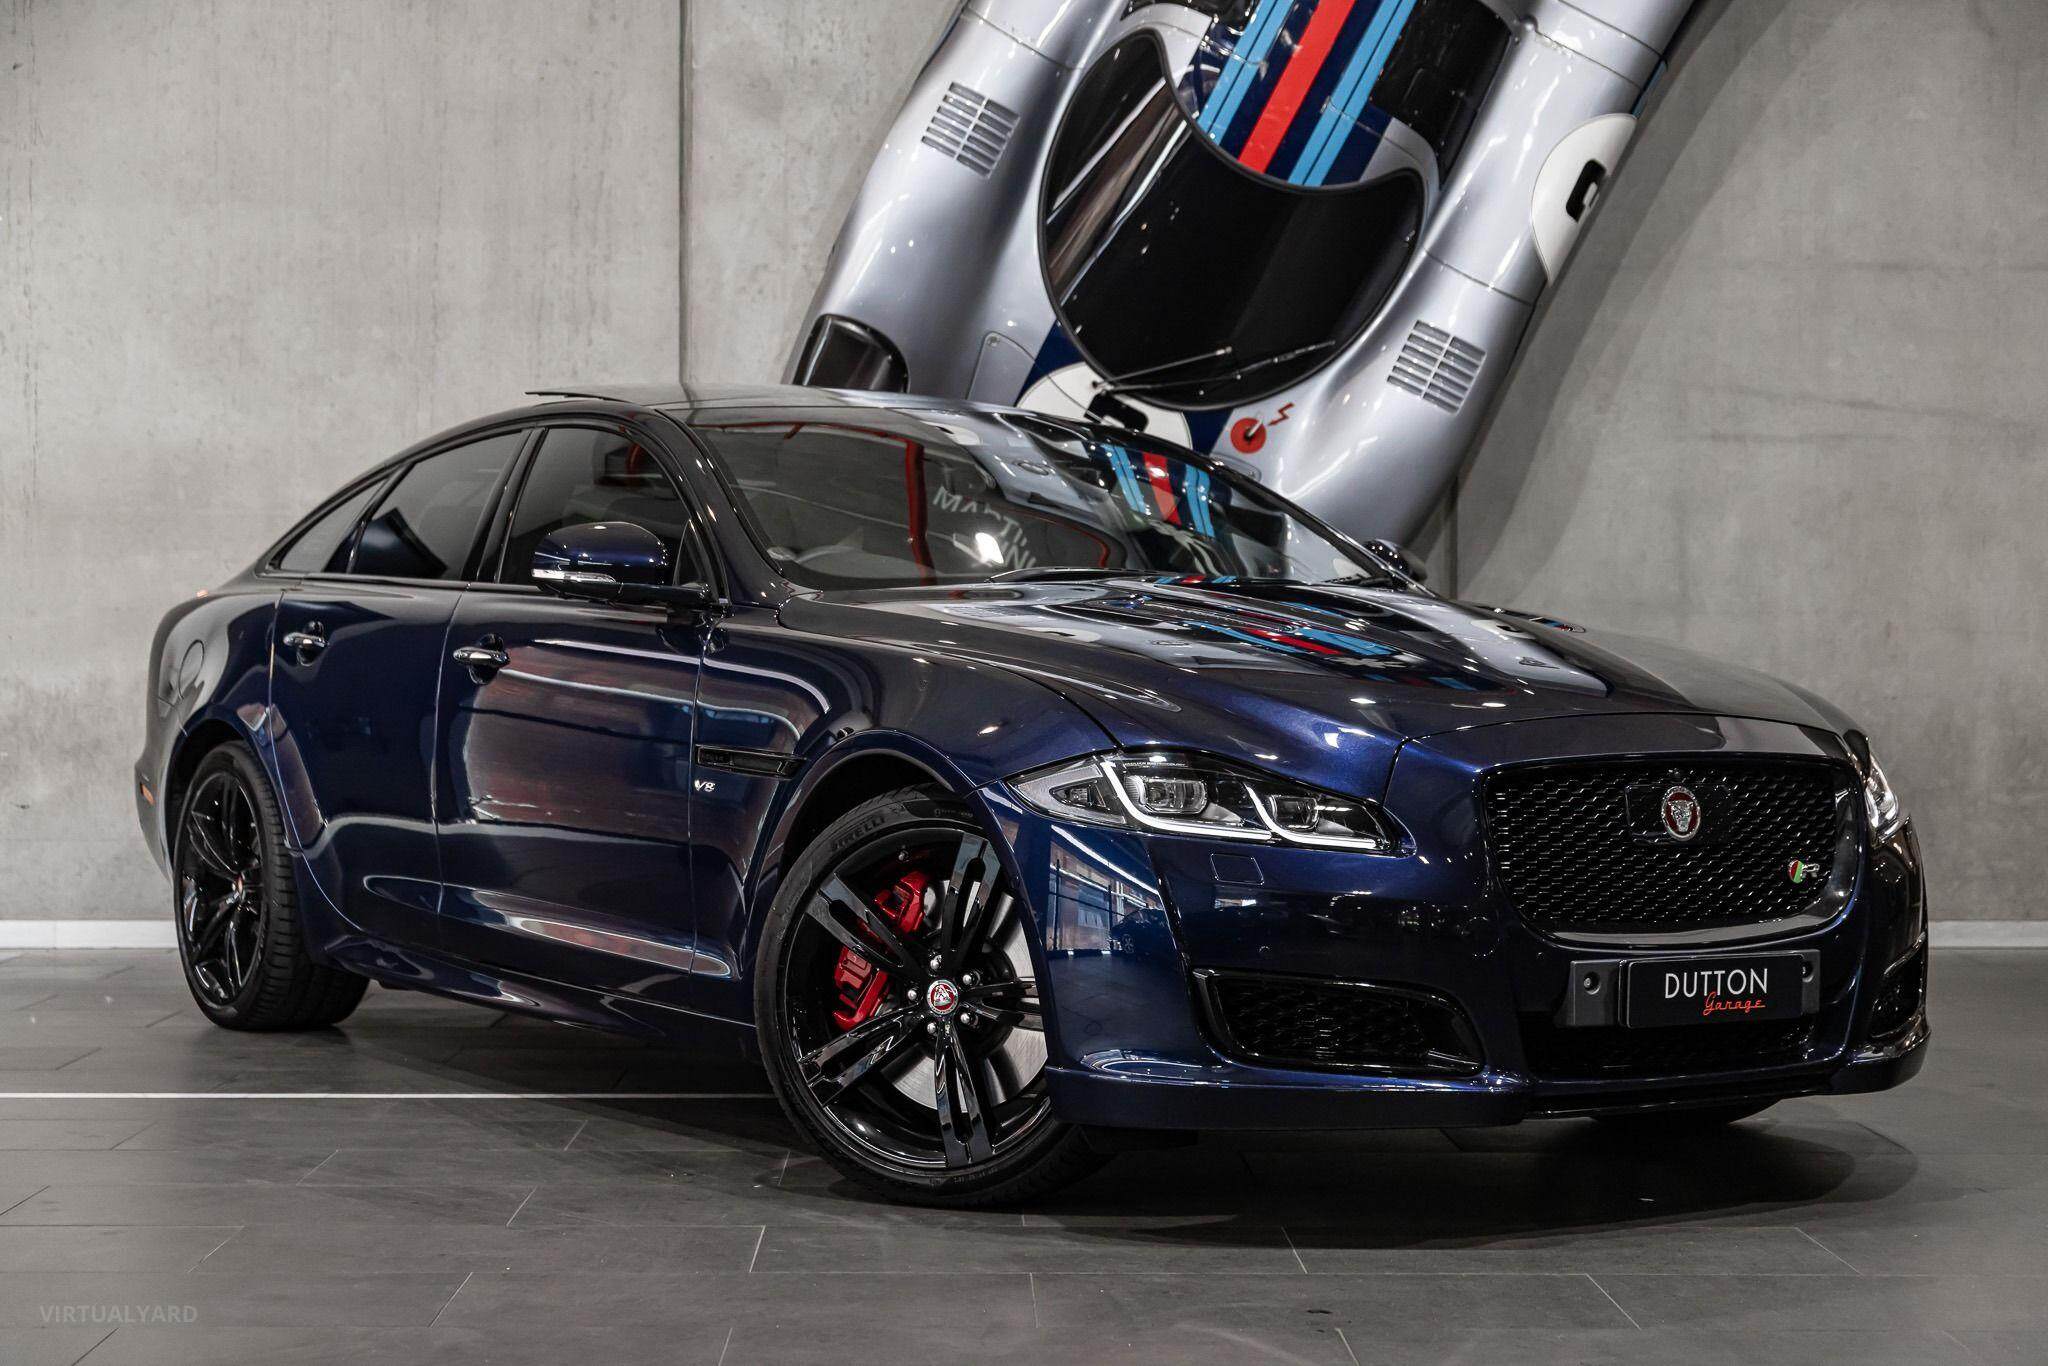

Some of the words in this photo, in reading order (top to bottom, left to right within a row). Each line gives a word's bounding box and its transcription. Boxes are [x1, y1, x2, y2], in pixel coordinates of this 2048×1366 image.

[694, 779, 715, 793] V8
[1664, 968, 1769, 999] DUTTON
[1702, 991, 1767, 1016] Garage
